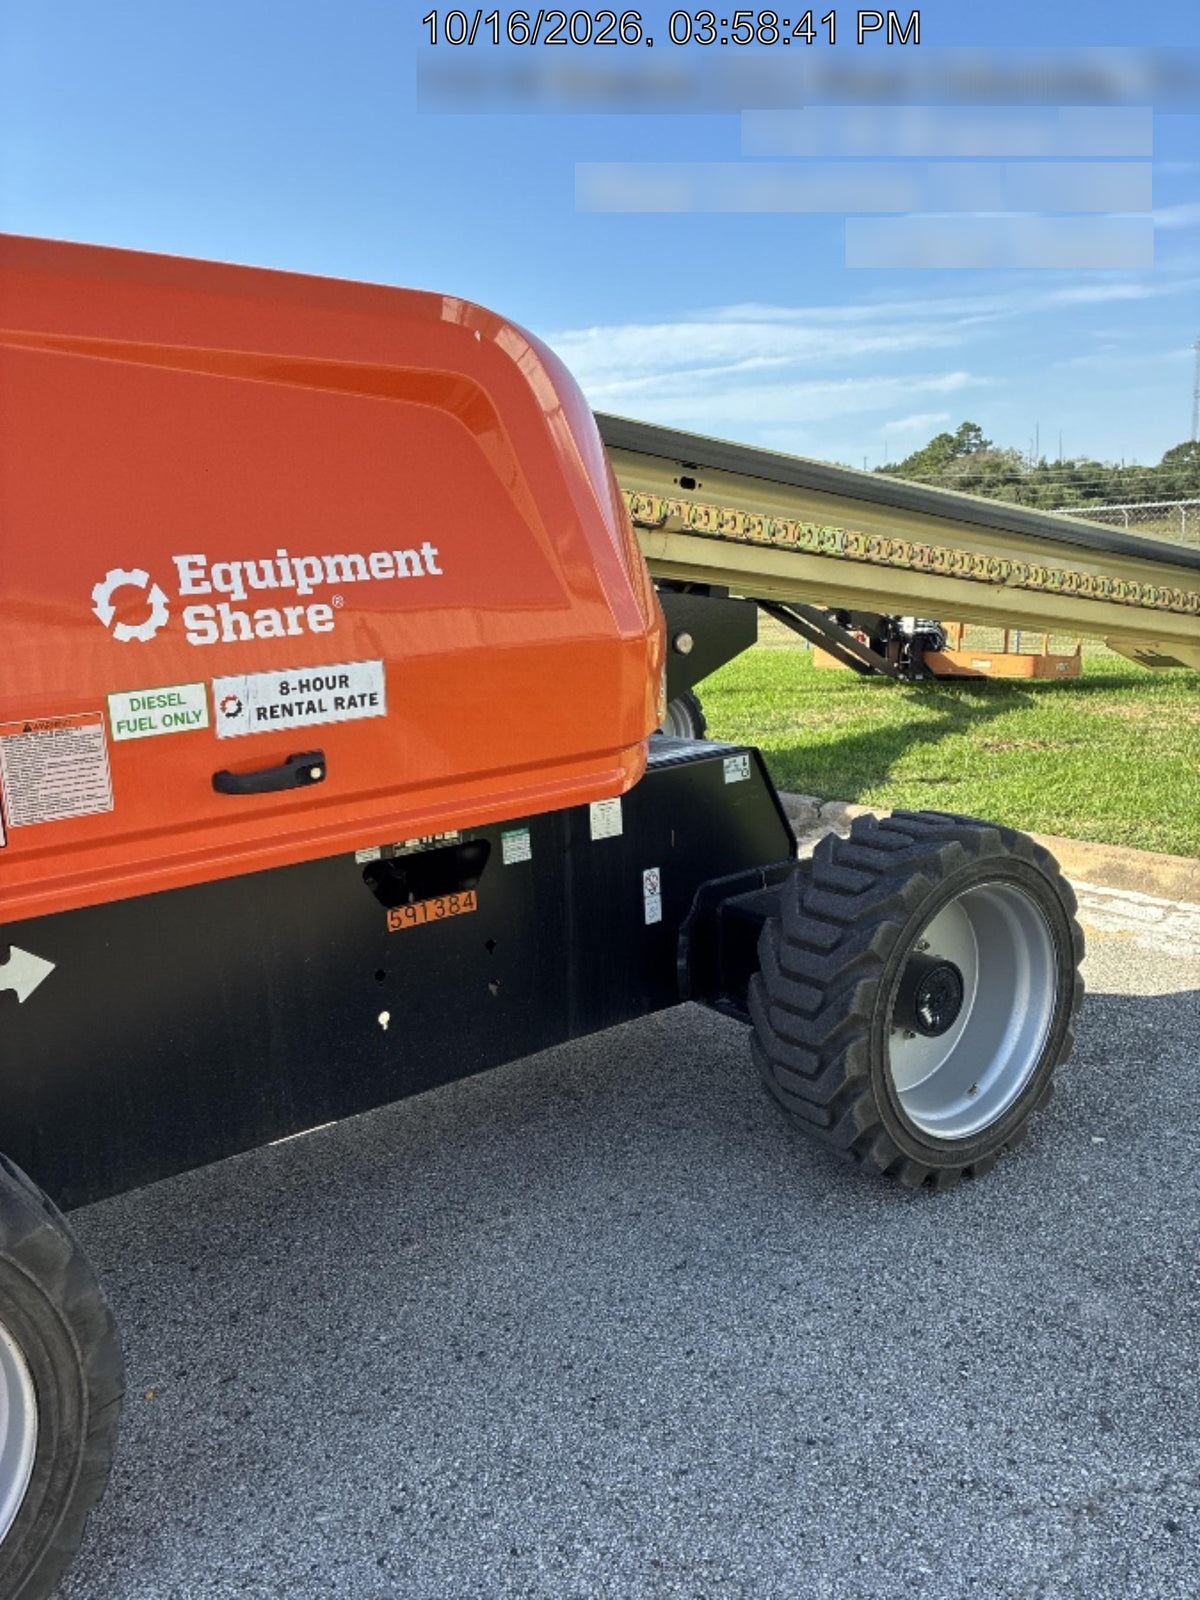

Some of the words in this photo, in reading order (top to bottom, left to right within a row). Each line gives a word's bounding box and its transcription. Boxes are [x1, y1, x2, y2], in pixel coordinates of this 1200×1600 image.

[172, 541, 443, 601] Equipment
[278, 674, 350, 696] 8-HOUR
[129, 692, 187, 712] DIESEL
[256, 699, 328, 721] RENTAL
[335, 692, 379, 710] RATE
[116, 717, 158, 734] FUEL
[165, 709, 203, 728] ONLY
[389, 891, 474, 929] 591384
